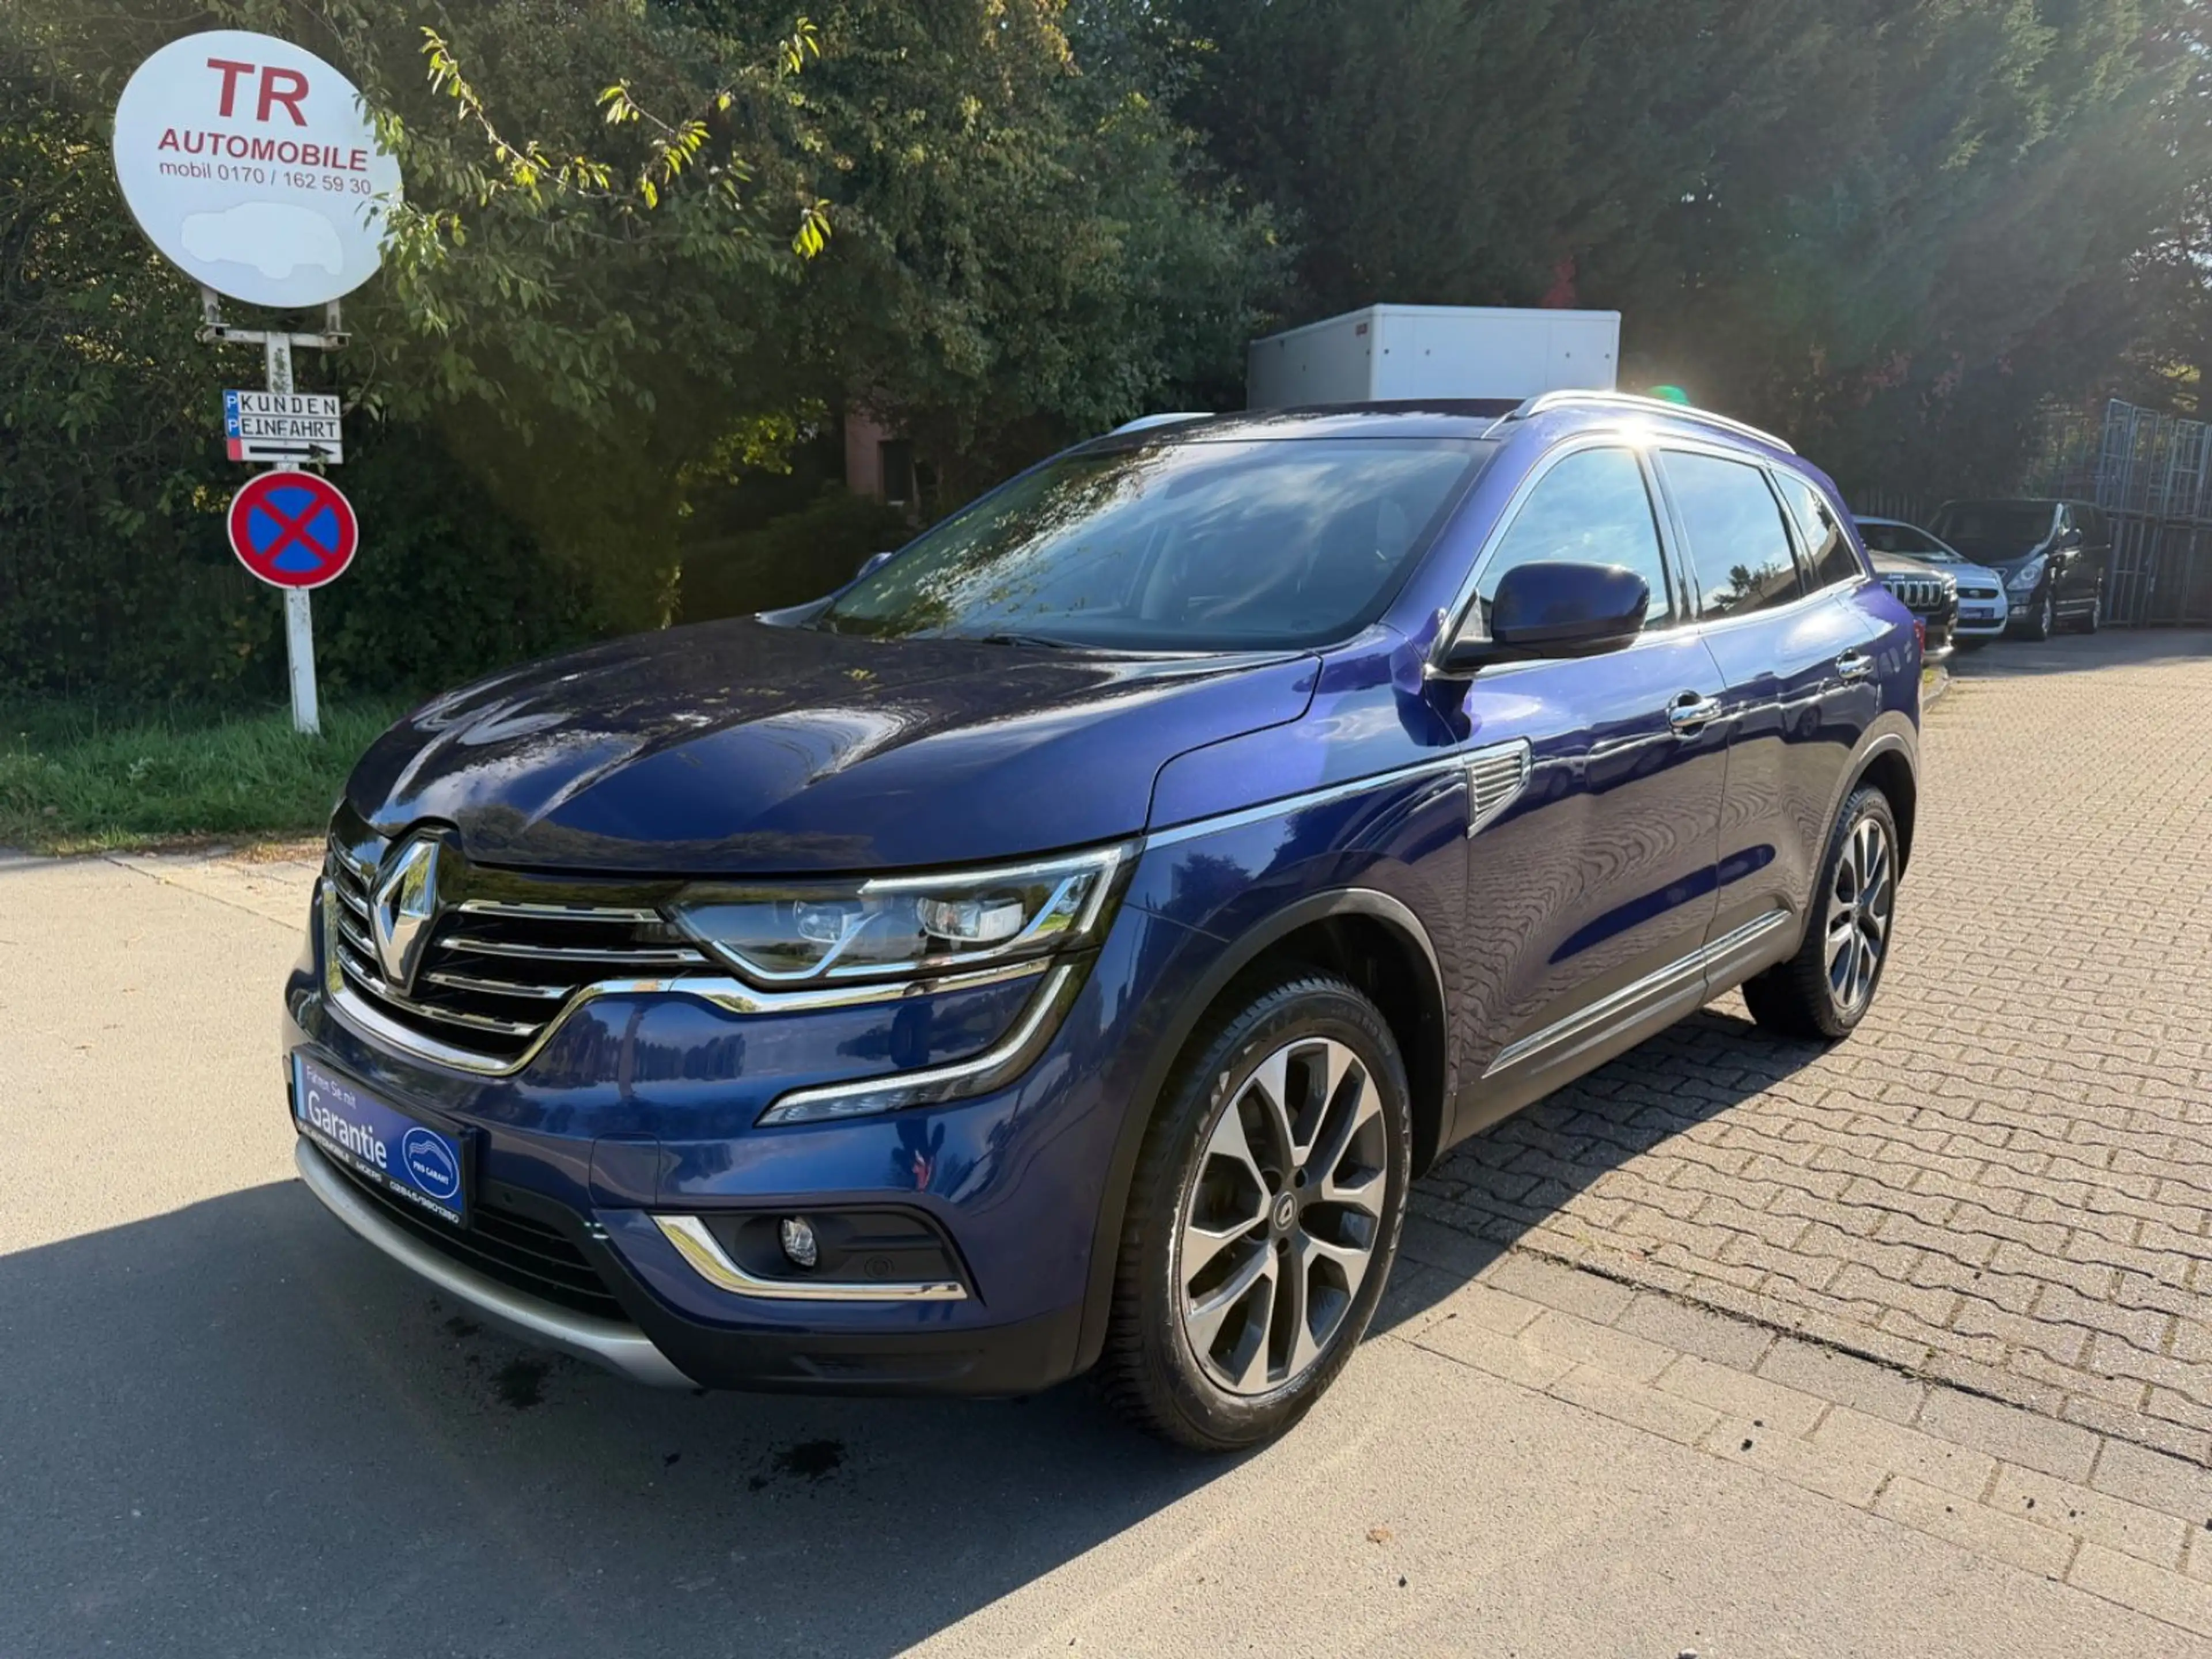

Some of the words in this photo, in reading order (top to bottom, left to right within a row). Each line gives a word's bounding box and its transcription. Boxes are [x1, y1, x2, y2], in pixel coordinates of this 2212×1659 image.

[207, 58, 309, 127] TR
[158, 128, 368, 172] AUTOMOBILE
[160, 161, 211, 178] mobil
[218, 164, 265, 184] 0170
[270, 169, 276, 186] /
[284, 171, 317, 190] 162
[321, 175, 344, 192] 59
[349, 177, 372, 195] 30
[241, 394, 336, 415] KUNDEN
[241, 418, 336, 438] EINFAHRT
[308, 1090, 387, 1169] Garantie
